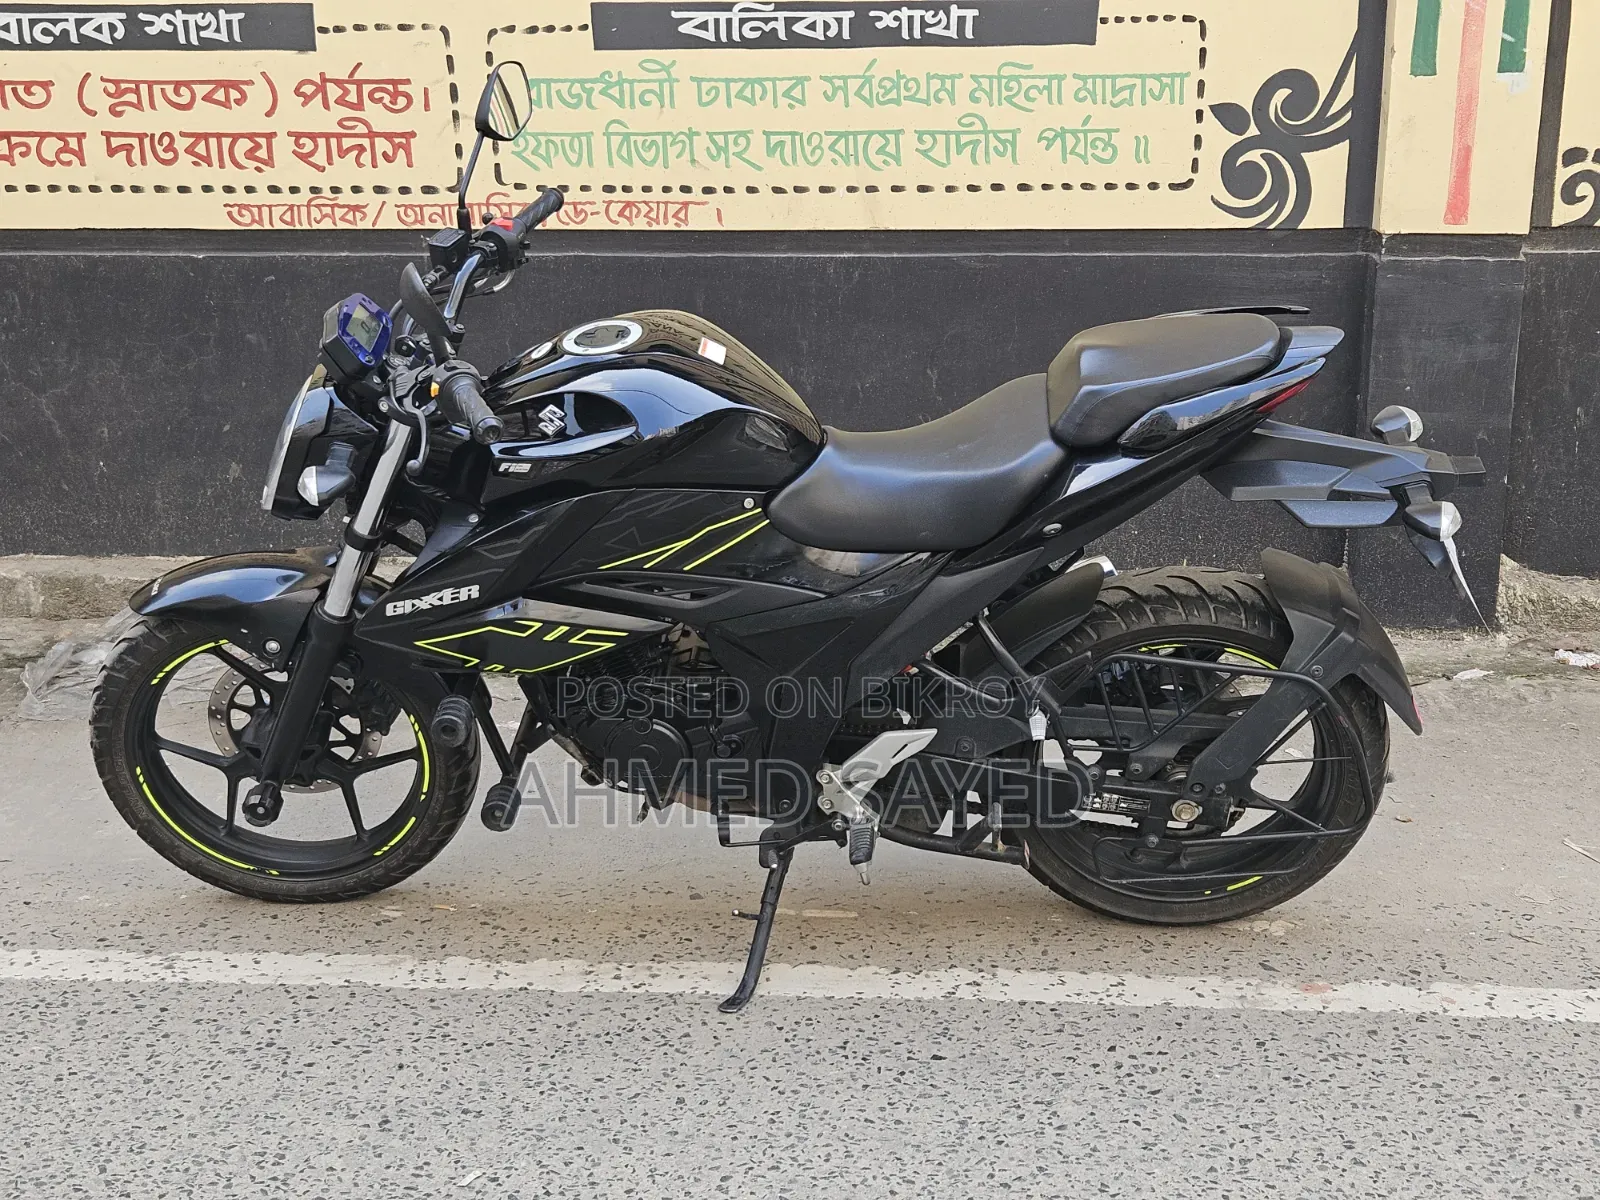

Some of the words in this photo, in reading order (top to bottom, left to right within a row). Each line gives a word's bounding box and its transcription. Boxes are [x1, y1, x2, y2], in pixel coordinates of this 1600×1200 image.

[137, 9, 246, 46] শাখা
[671, 3, 854, 42] বালিকা
[869, 4, 980, 41] শাখা
[969, 62, 1067, 113] মহিলা
[1072, 71, 1191, 108] মাদ্রাসা
[287, 117, 417, 172] হাদীস
[603, 119, 701, 170] বিভাগ
[705, 129, 763, 172] সহ
[914, 113, 1021, 168] হাদীস
